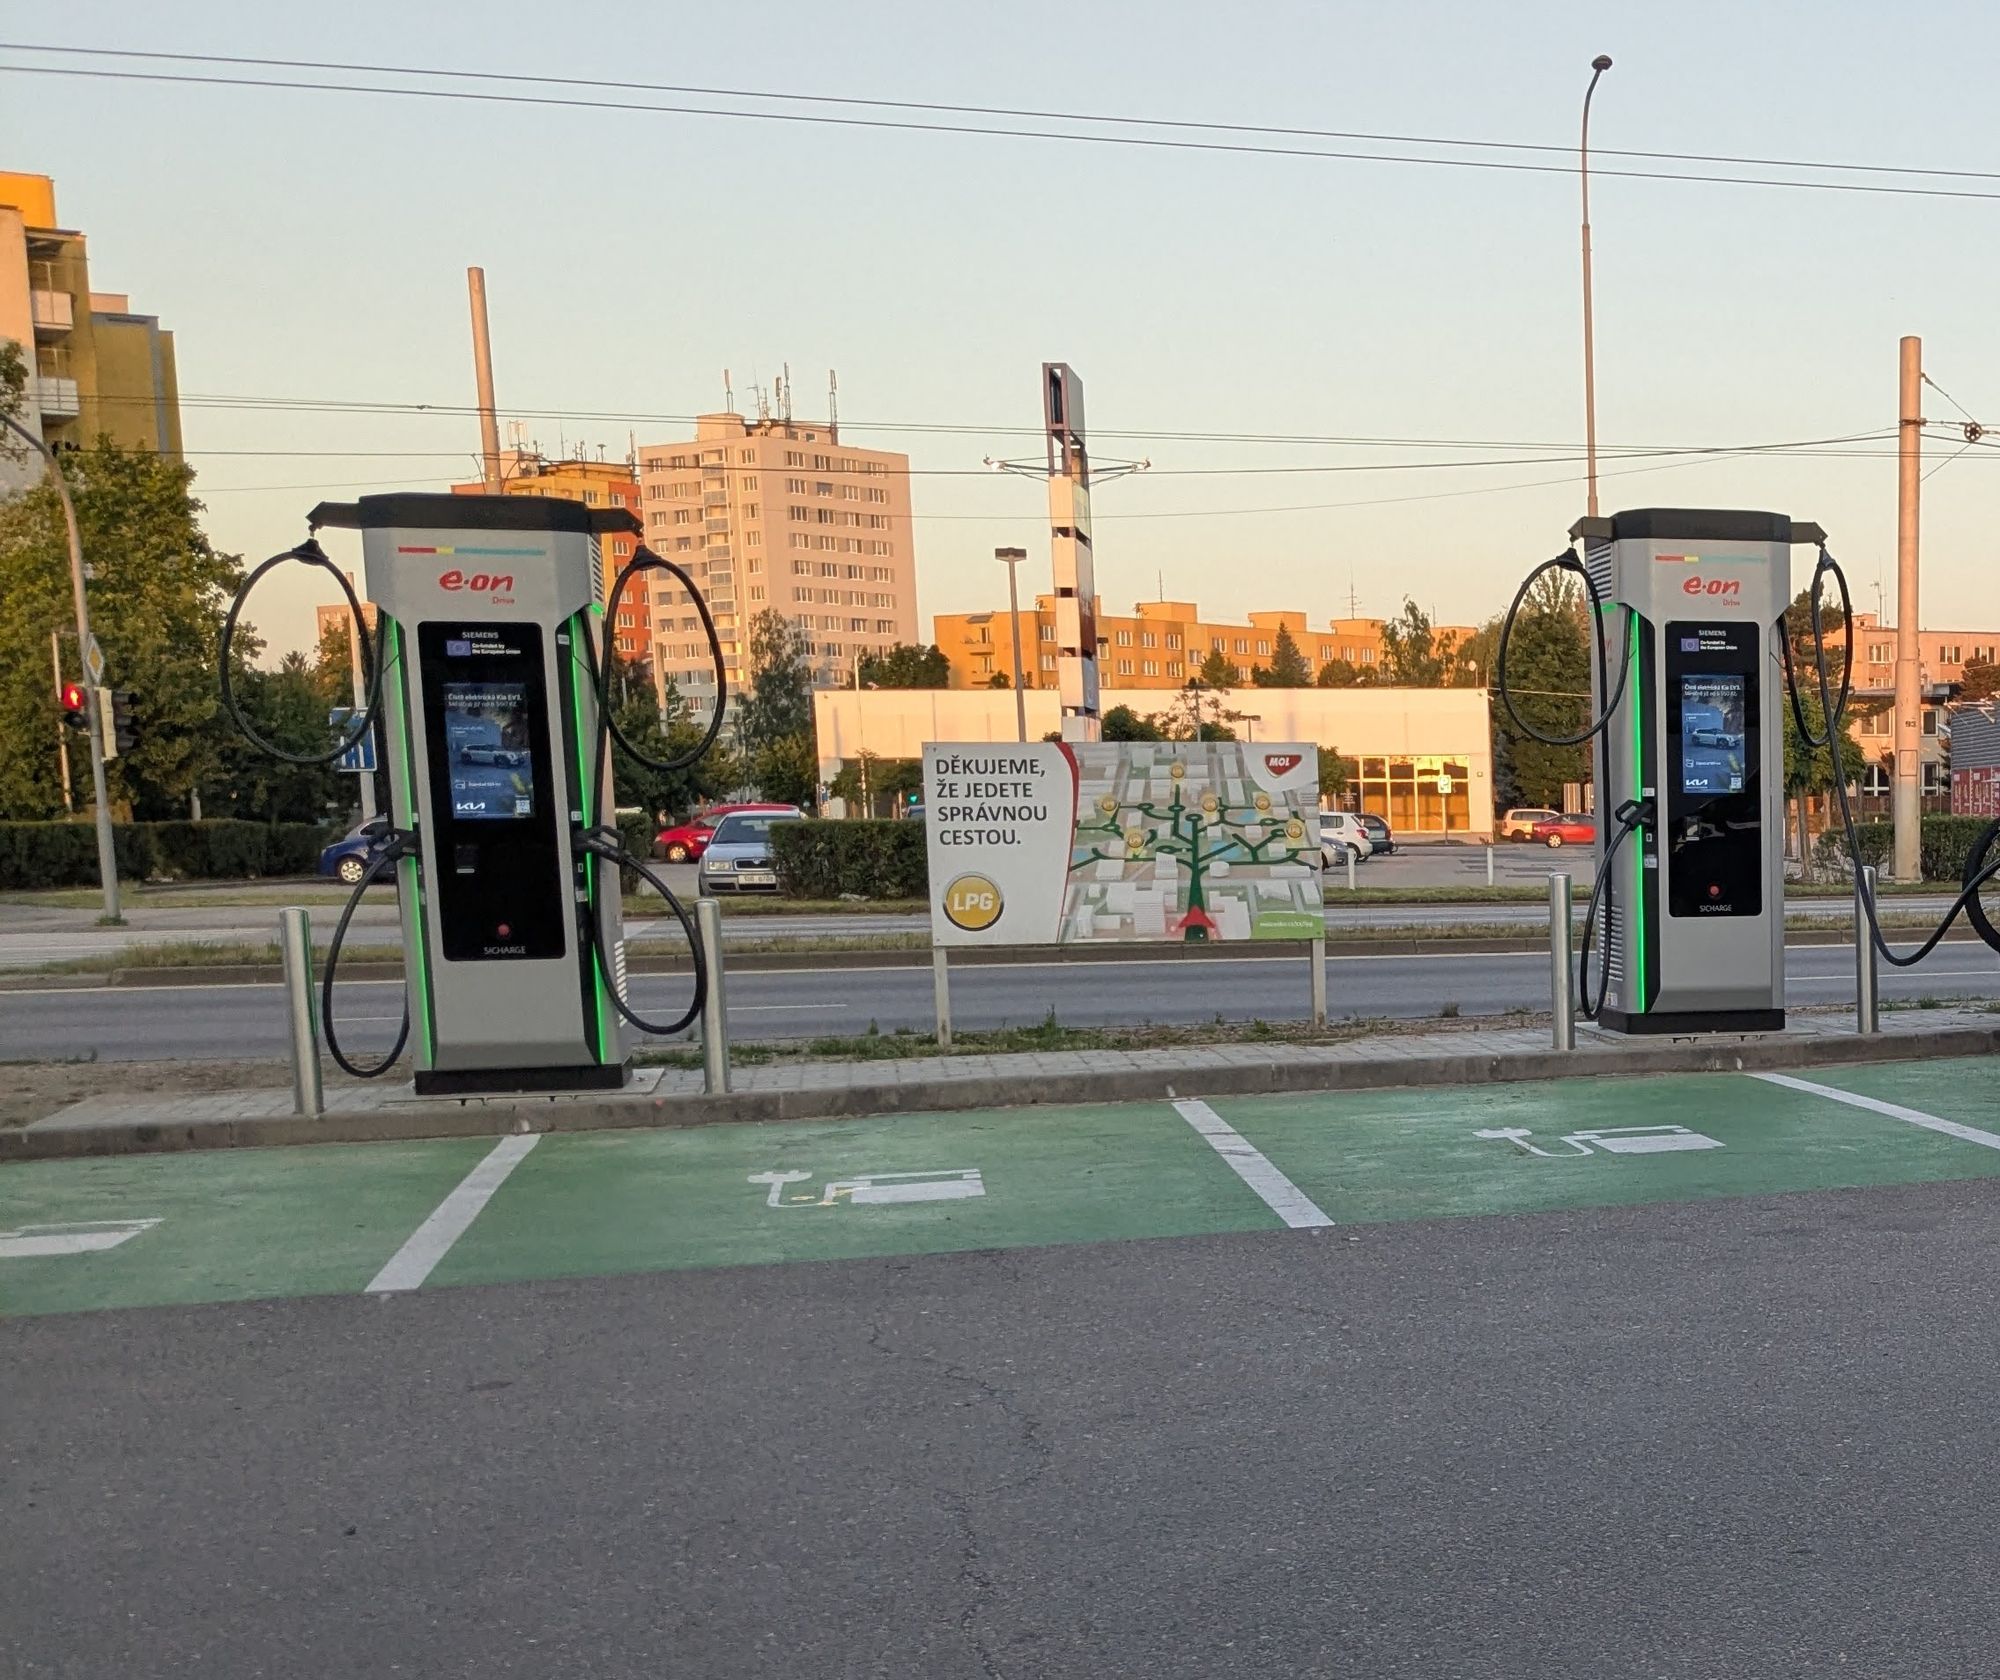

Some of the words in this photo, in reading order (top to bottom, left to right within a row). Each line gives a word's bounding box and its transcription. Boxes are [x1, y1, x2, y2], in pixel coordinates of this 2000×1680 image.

[492, 596, 515, 605] Drive
[462, 631, 499, 639] SIEMENS
[936, 754, 1046, 778] DĚKUJEME,
[1269, 757, 1290, 767] MOL
[936, 778, 959, 798] ŽE
[964, 782, 1033, 798] JEDETE
[937, 802, 1048, 822] SPRÁVNOU
[939, 829, 1022, 846] CESTOU.
[953, 892, 994, 912] LPG
[1699, 904, 1732, 912] SICHARGE
[484, 945, 526, 955] SICHARGE
